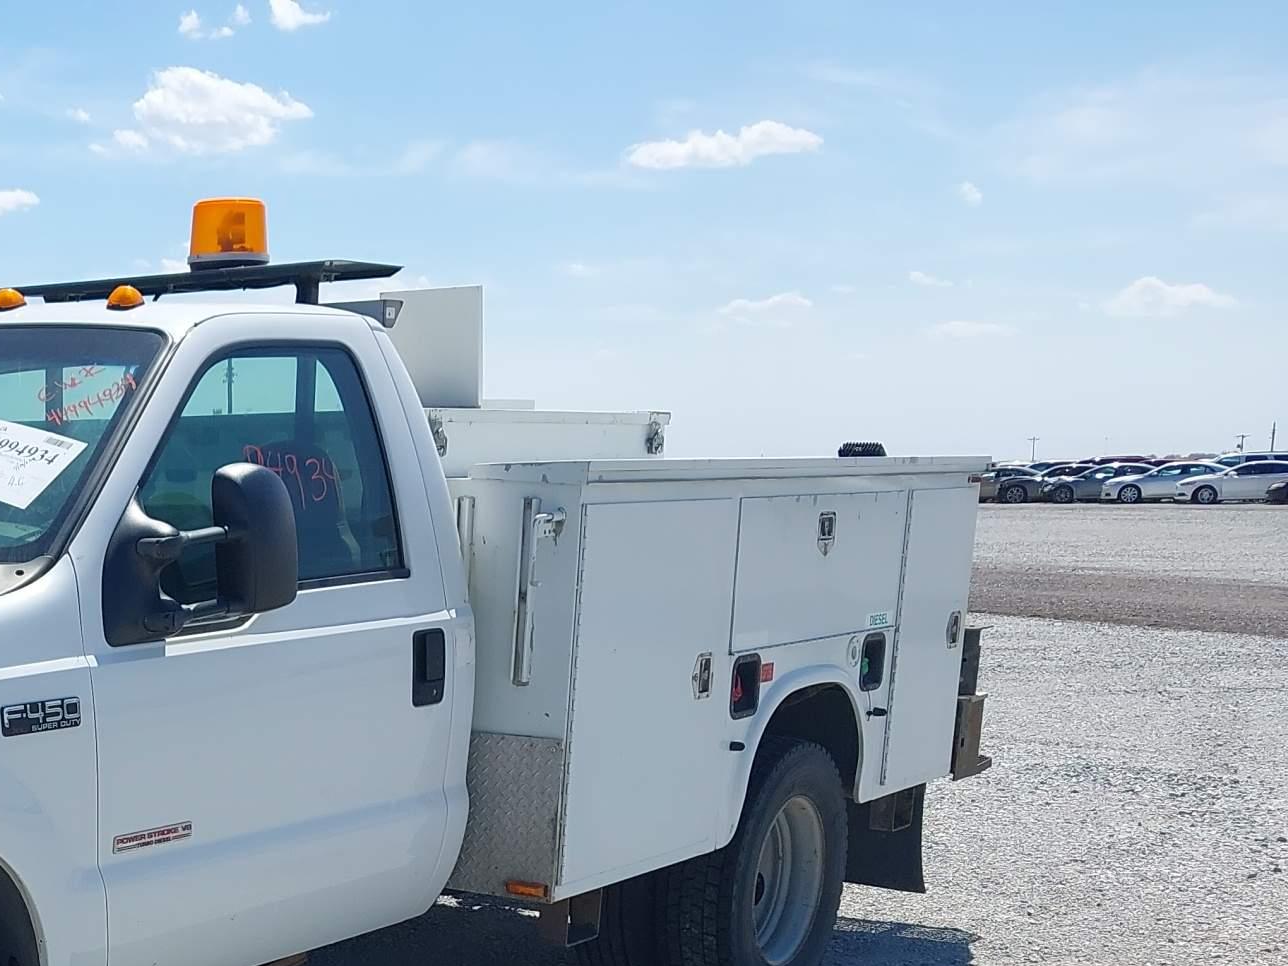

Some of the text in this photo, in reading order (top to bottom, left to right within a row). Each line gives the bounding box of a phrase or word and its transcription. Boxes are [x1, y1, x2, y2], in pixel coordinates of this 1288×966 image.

[869, 613, 888, 626] DIESEL
[31, 718, 81, 732] SUPER DUTY
[116, 833, 146, 846] POWER
[147, 826, 179, 839] STROKE
